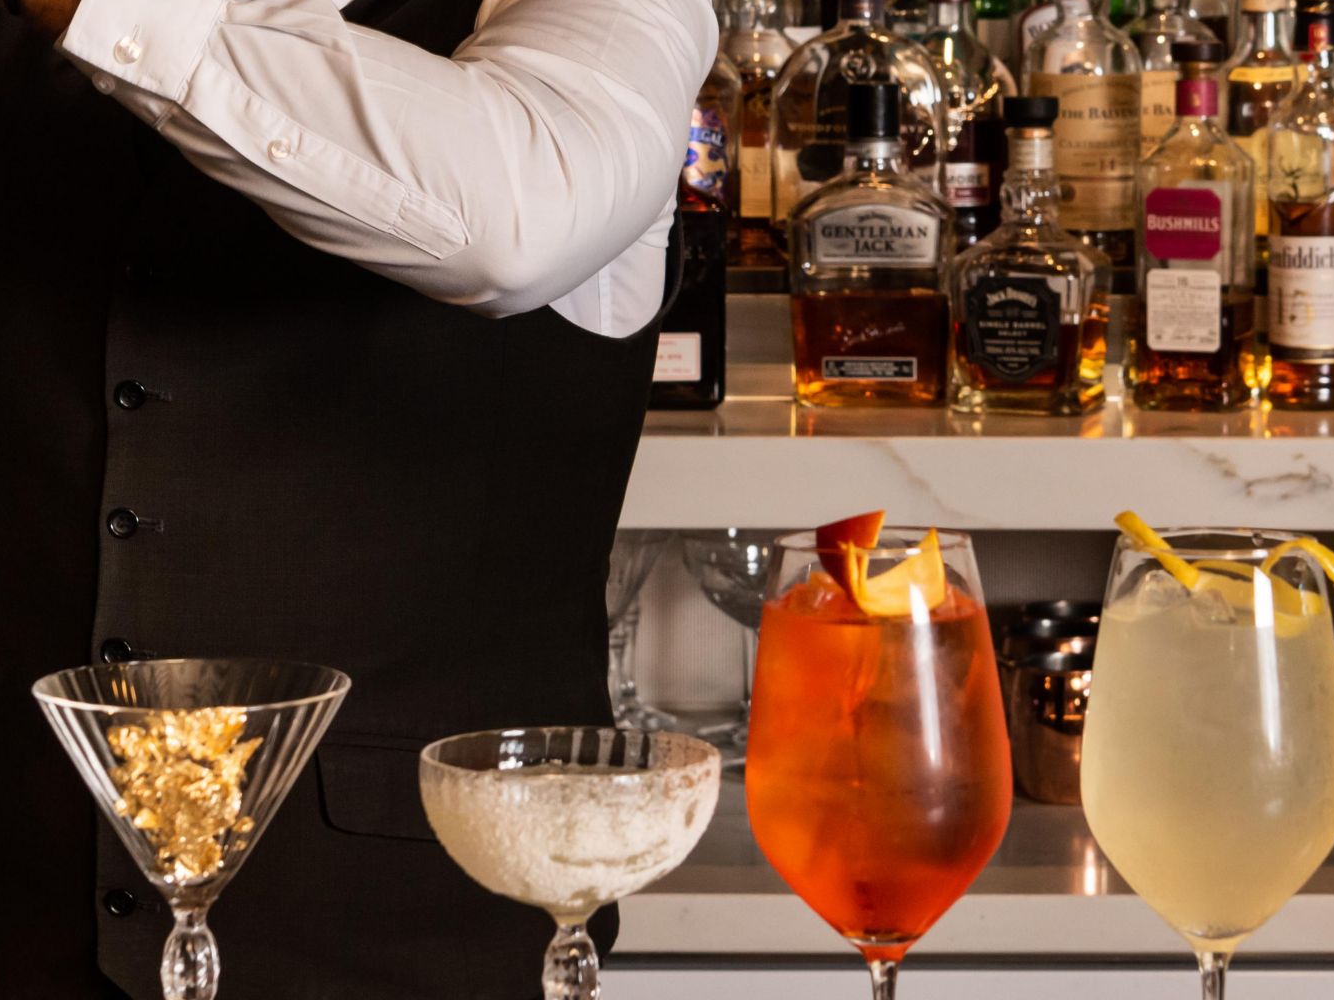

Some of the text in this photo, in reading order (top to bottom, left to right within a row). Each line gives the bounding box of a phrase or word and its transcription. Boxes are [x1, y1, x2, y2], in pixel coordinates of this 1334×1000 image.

[786, 122, 846, 132] WOODFO
[1146, 213, 1220, 232] BUSHMILLS
[820, 225, 929, 239] GENTLEMAN
[854, 239, 895, 254] JACK
